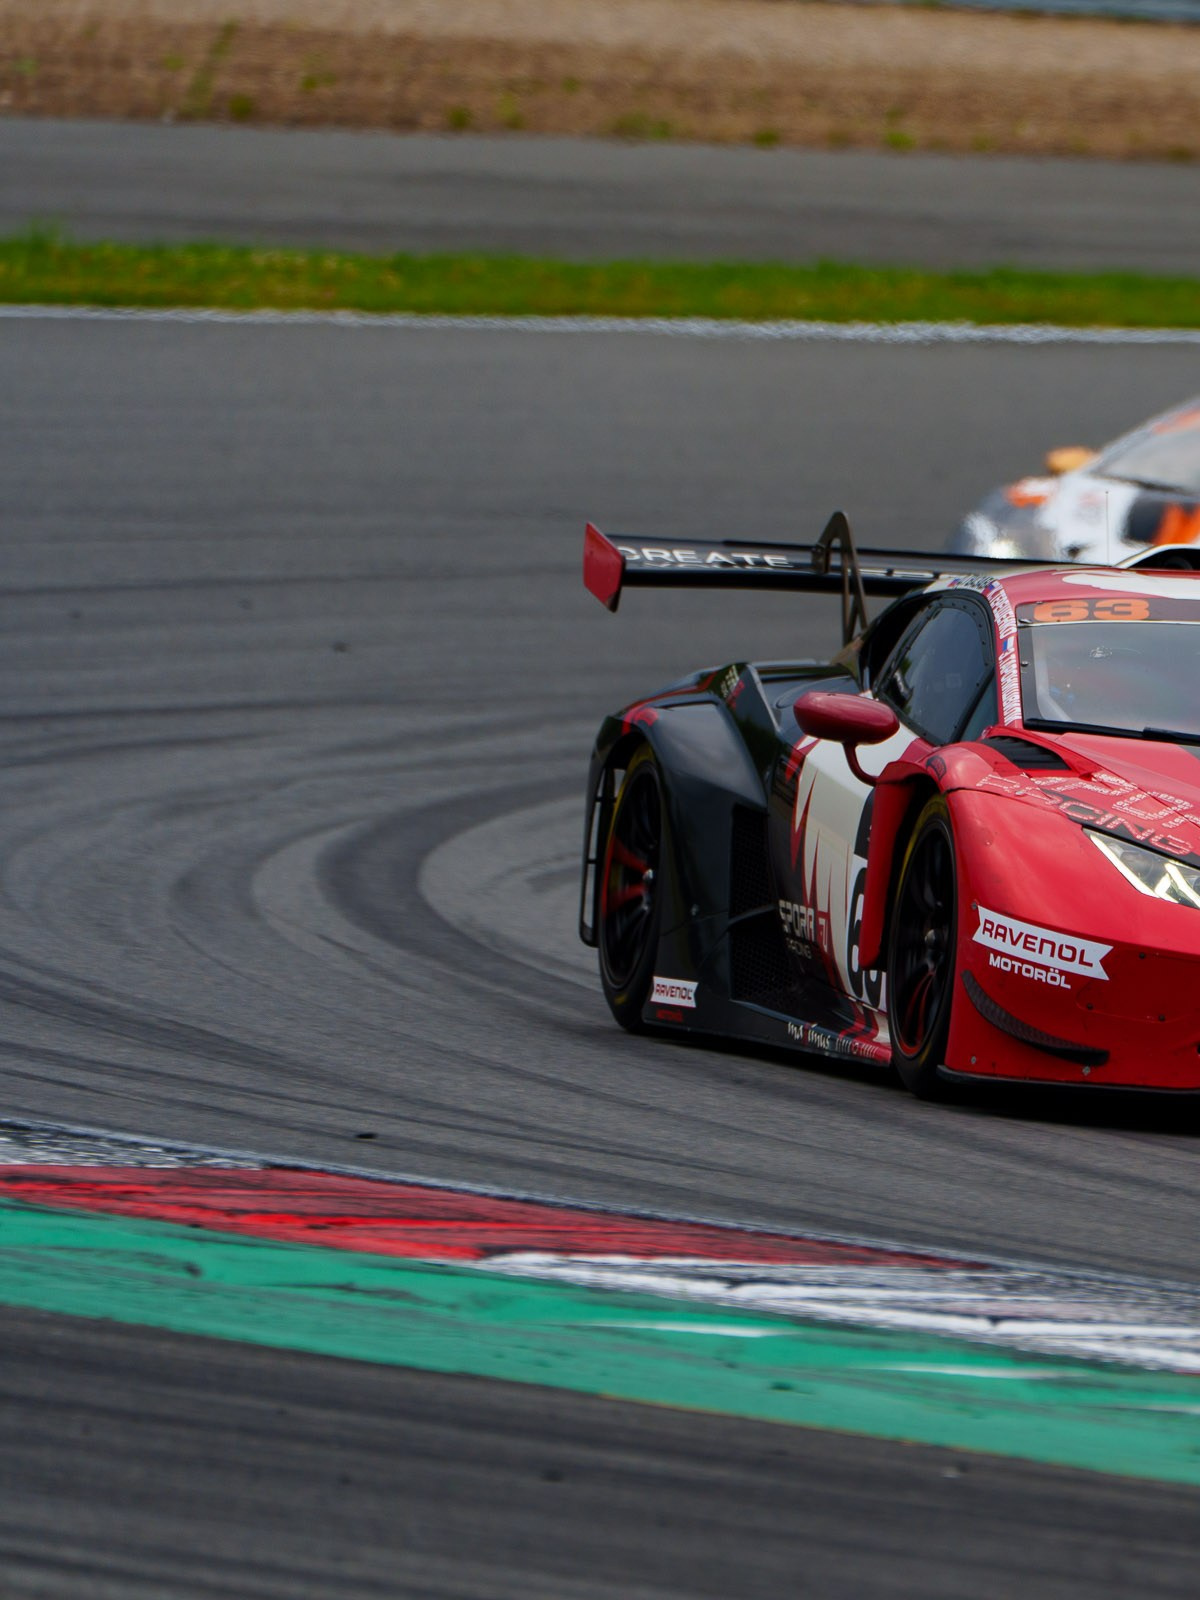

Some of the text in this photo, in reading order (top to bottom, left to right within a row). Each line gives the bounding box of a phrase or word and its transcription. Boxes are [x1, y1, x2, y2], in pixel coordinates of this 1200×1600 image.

[1033, 598, 1150, 622] 63
[982, 918, 1094, 968] RAVENOL
[988, 952, 1072, 990] MOTORÖL
[655, 983, 693, 1001] RAVENOL
